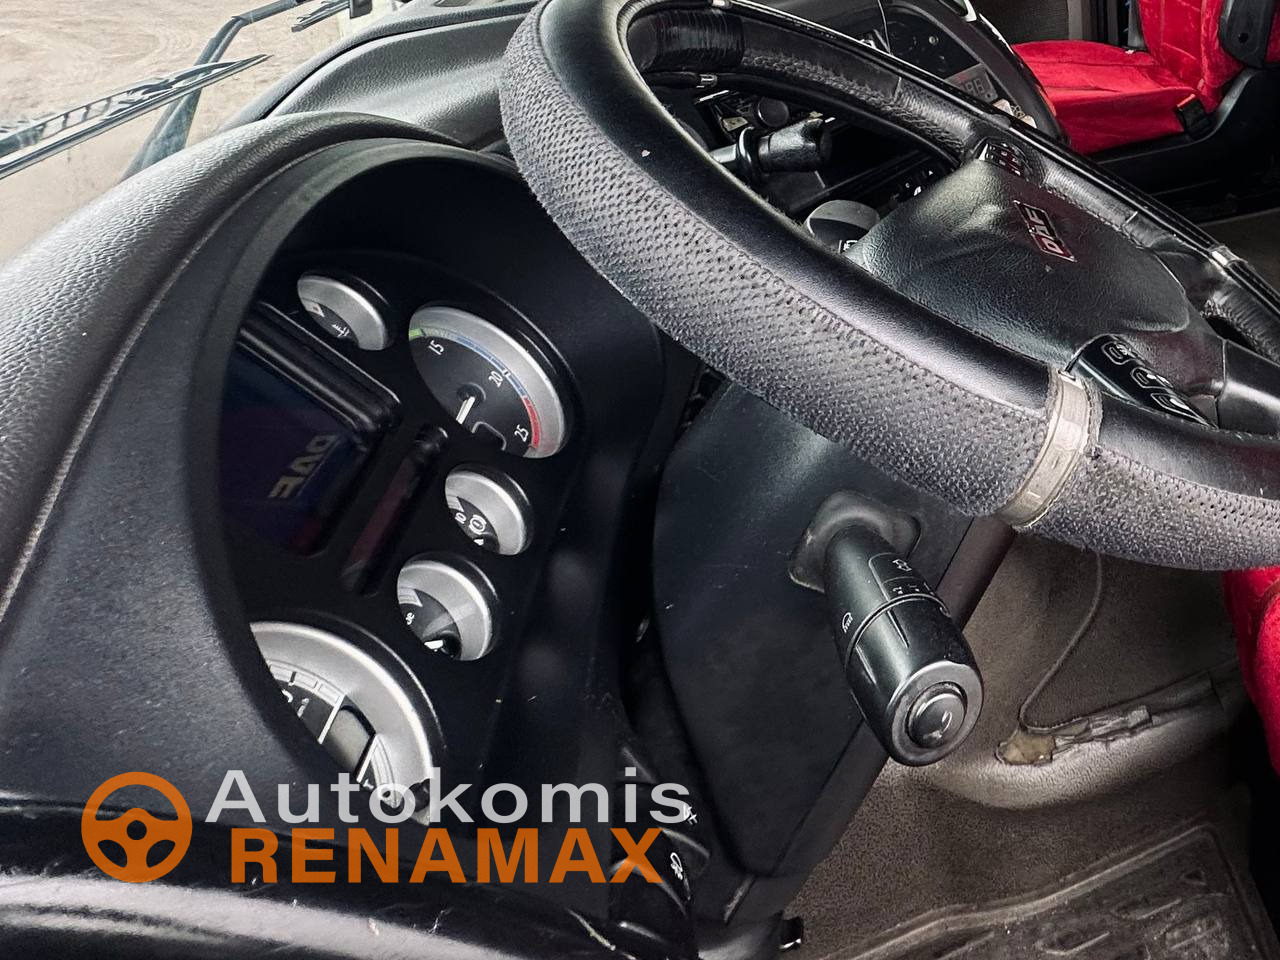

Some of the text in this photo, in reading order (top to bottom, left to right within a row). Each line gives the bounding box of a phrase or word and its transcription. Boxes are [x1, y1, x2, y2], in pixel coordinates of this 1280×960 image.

[428, 339, 445, 356] 15
[488, 370, 504, 388] 20
[514, 424, 530, 443] 25
[267, 435, 338, 499] DAF
